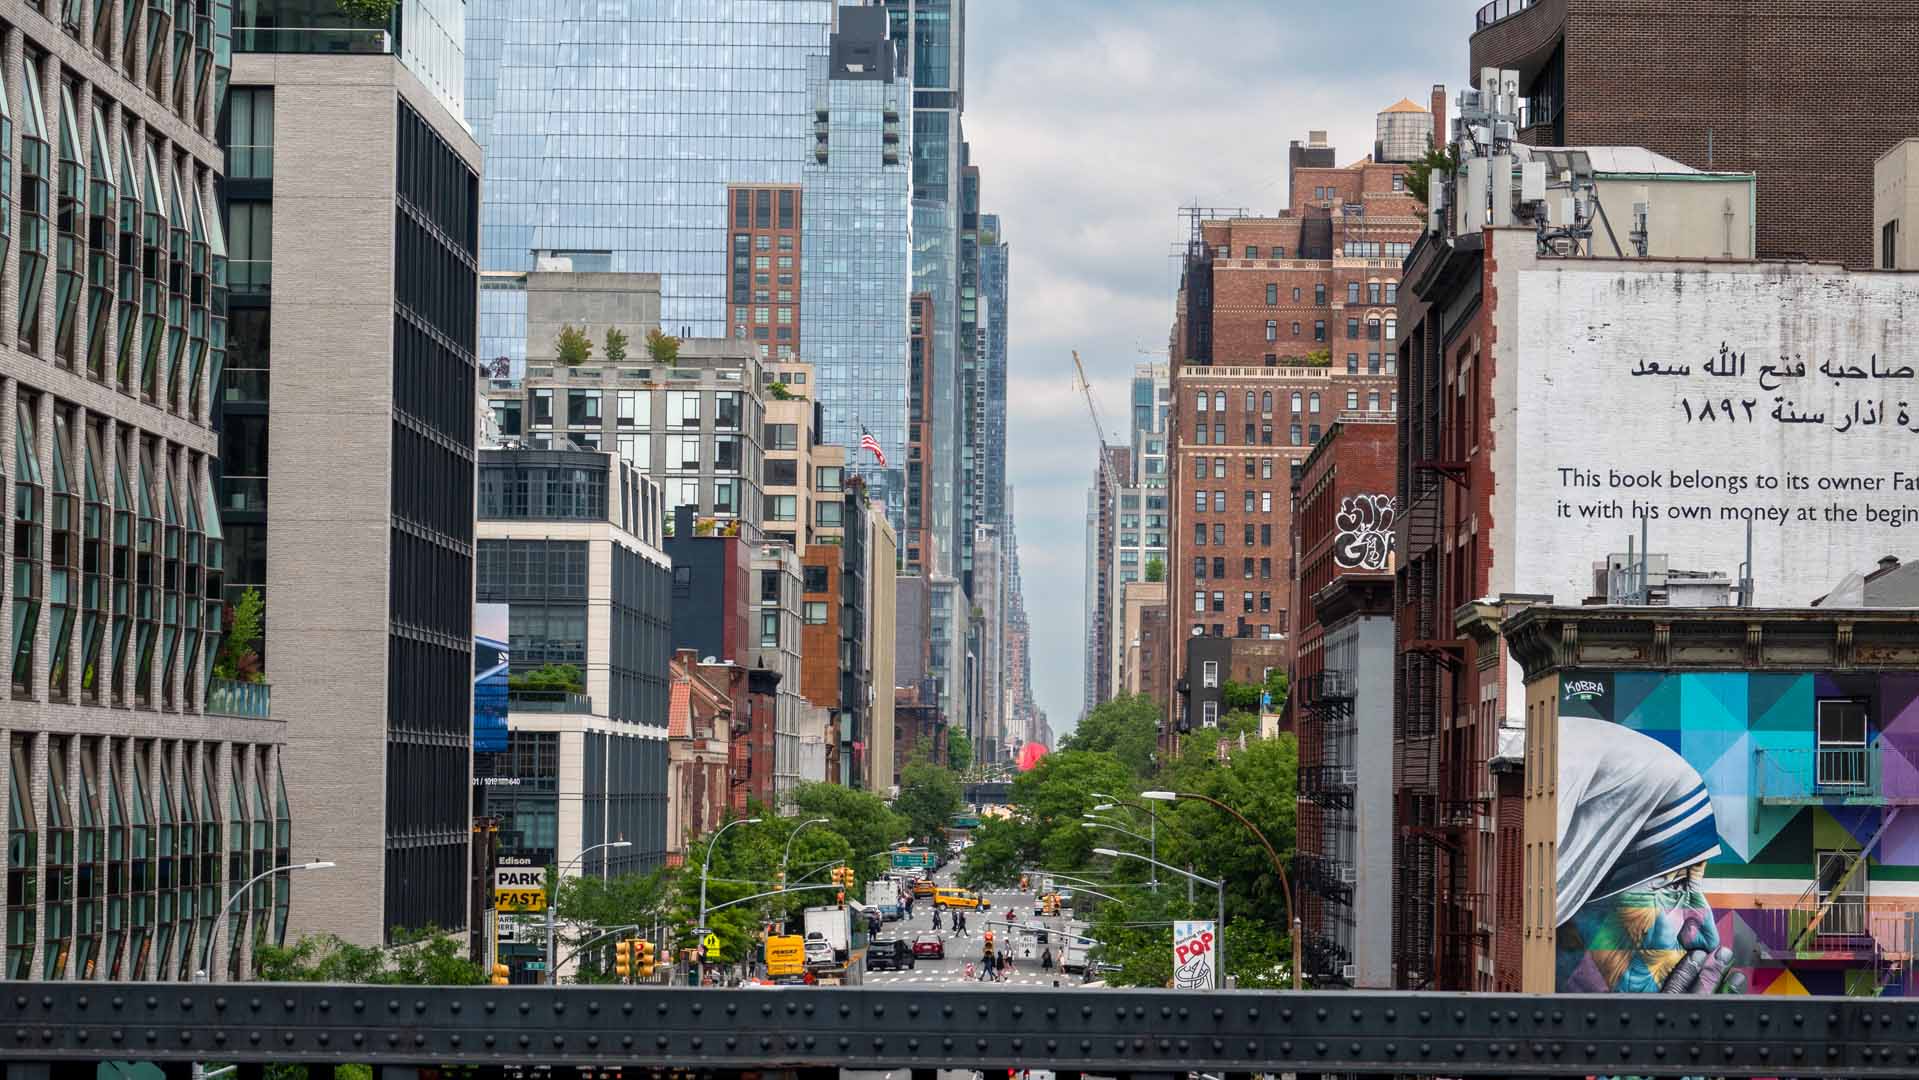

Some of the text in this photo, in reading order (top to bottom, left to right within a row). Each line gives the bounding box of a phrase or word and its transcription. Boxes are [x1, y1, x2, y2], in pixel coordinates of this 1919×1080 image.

[1631, 359, 1690, 377] سعد
[1759, 353, 1806, 392] فتح
[1819, 353, 1915, 387] صاحبه
[1771, 397, 1825, 424] سنة
[1557, 467, 1601, 488] This
[1609, 469, 1662, 488] book
[1670, 469, 1748, 495] belongs
[1756, 474, 1778, 490] to
[1786, 471, 1810, 490] its
[1817, 477, 1886, 491] owner
[1557, 499, 1919, 528] it with his own money at the begin
[1564, 680, 1605, 694] KOBRA
[498, 856, 532, 866] Edison
[498, 873, 541, 885] PARK
[499, 893, 541, 906] FAST
[1175, 932, 1214, 964] POP
